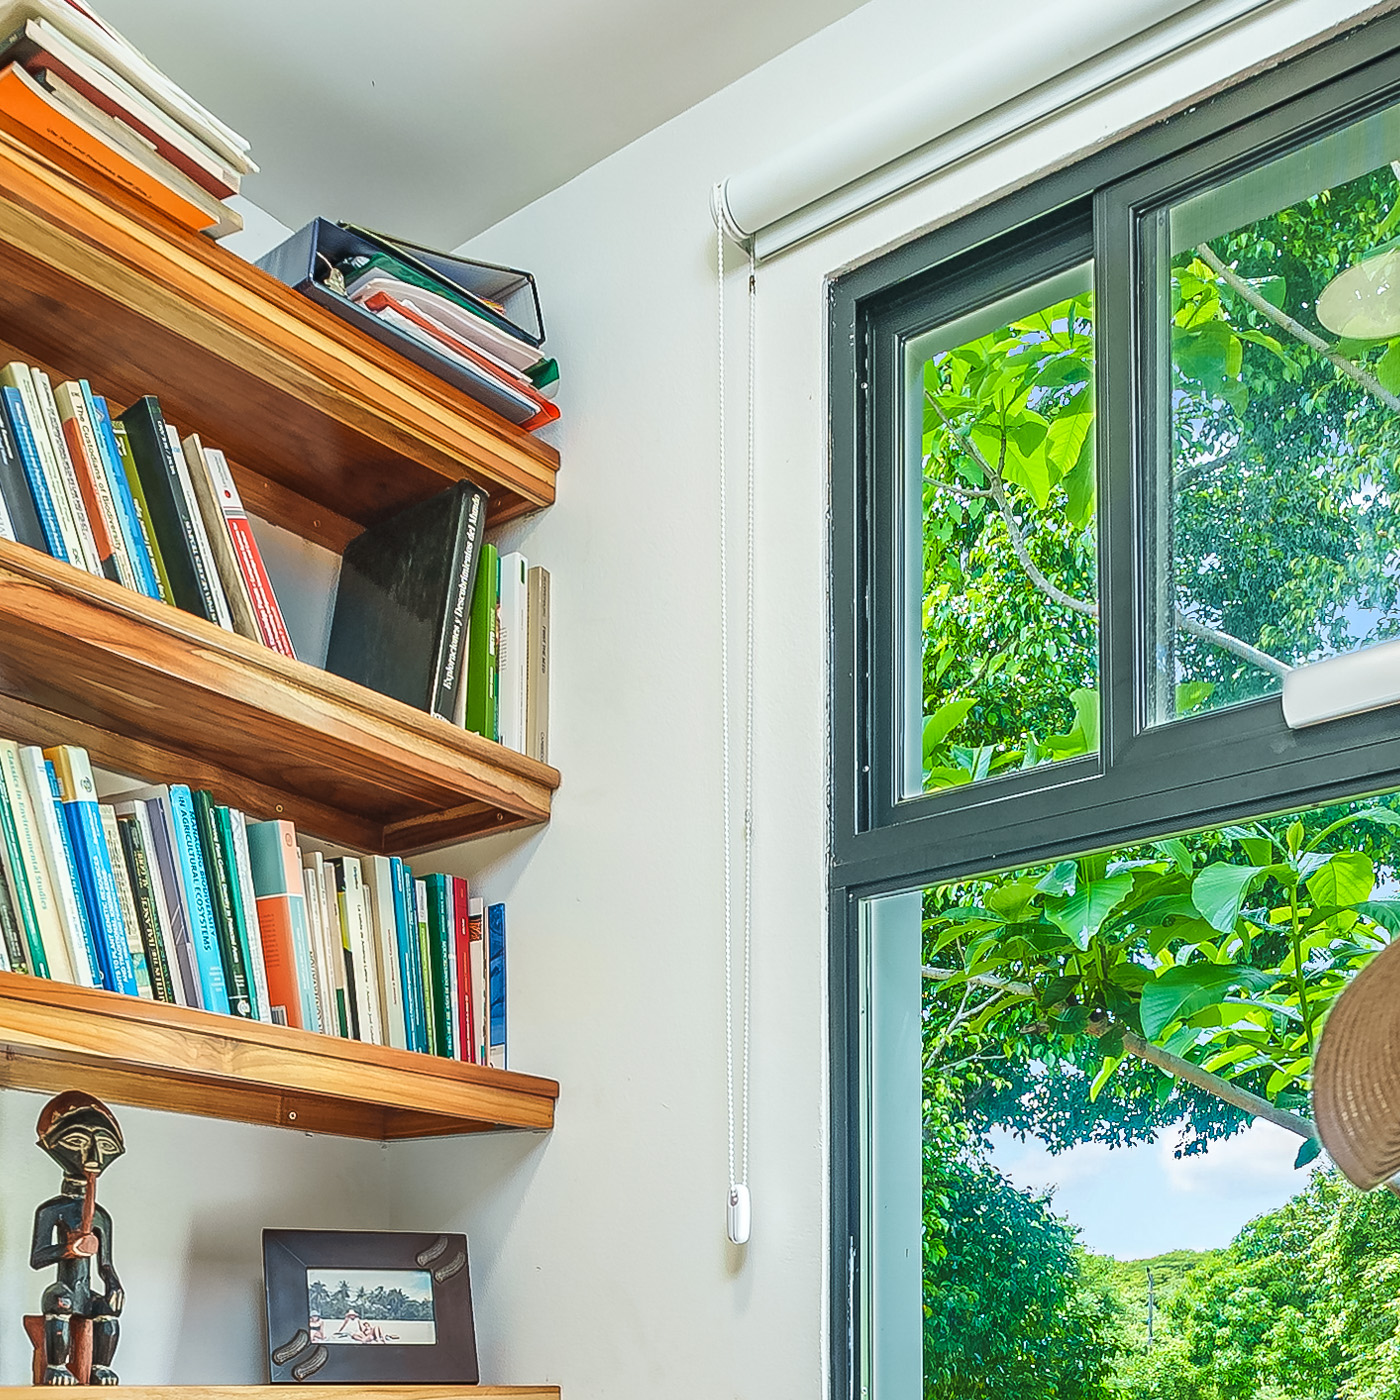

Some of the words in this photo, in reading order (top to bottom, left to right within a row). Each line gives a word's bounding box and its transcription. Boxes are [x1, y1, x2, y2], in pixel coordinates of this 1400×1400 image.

[74, 402, 87, 423] The
[29, 456, 38, 468] and
[79, 423, 103, 482] Custodians
[31, 466, 43, 486] Policy
[96, 480, 107, 494] of
[467, 492, 480, 526] Mundo
[46, 515, 56, 532] Latin
[99, 493, 124, 553] Biodiversity
[465, 523, 475, 542] del
[50, 530, 63, 557] America
[453, 539, 474, 617] Descubrimientos
[453, 616, 463, 626] y
[441, 624, 464, 690] Exploraciones
[5, 749, 22, 789] Classics
[14, 789, 24, 800] in
[178, 795, 186, 808] IN
[17, 801, 40, 874] Environmental
[207, 807, 219, 842] Conserving
[180, 809, 199, 883] AGRICULTURAL
[214, 842, 222, 859] Plant
[91, 854, 107, 901] RESOURCES
[217, 858, 227, 883] Genetic
[33, 874, 49, 911] Studies
[220, 882, 231, 909] Diversity
[100, 900, 114, 934] GENETIC
[193, 885, 211, 952] ECOSYSTEMS
[225, 908, 232, 917] in
[226, 916, 237, 946] Protected
[107, 933, 119, 960] PLANT
[231, 945, 240, 964] Areas
[112, 959, 121, 970] TO
[119, 965, 128, 982] AND
